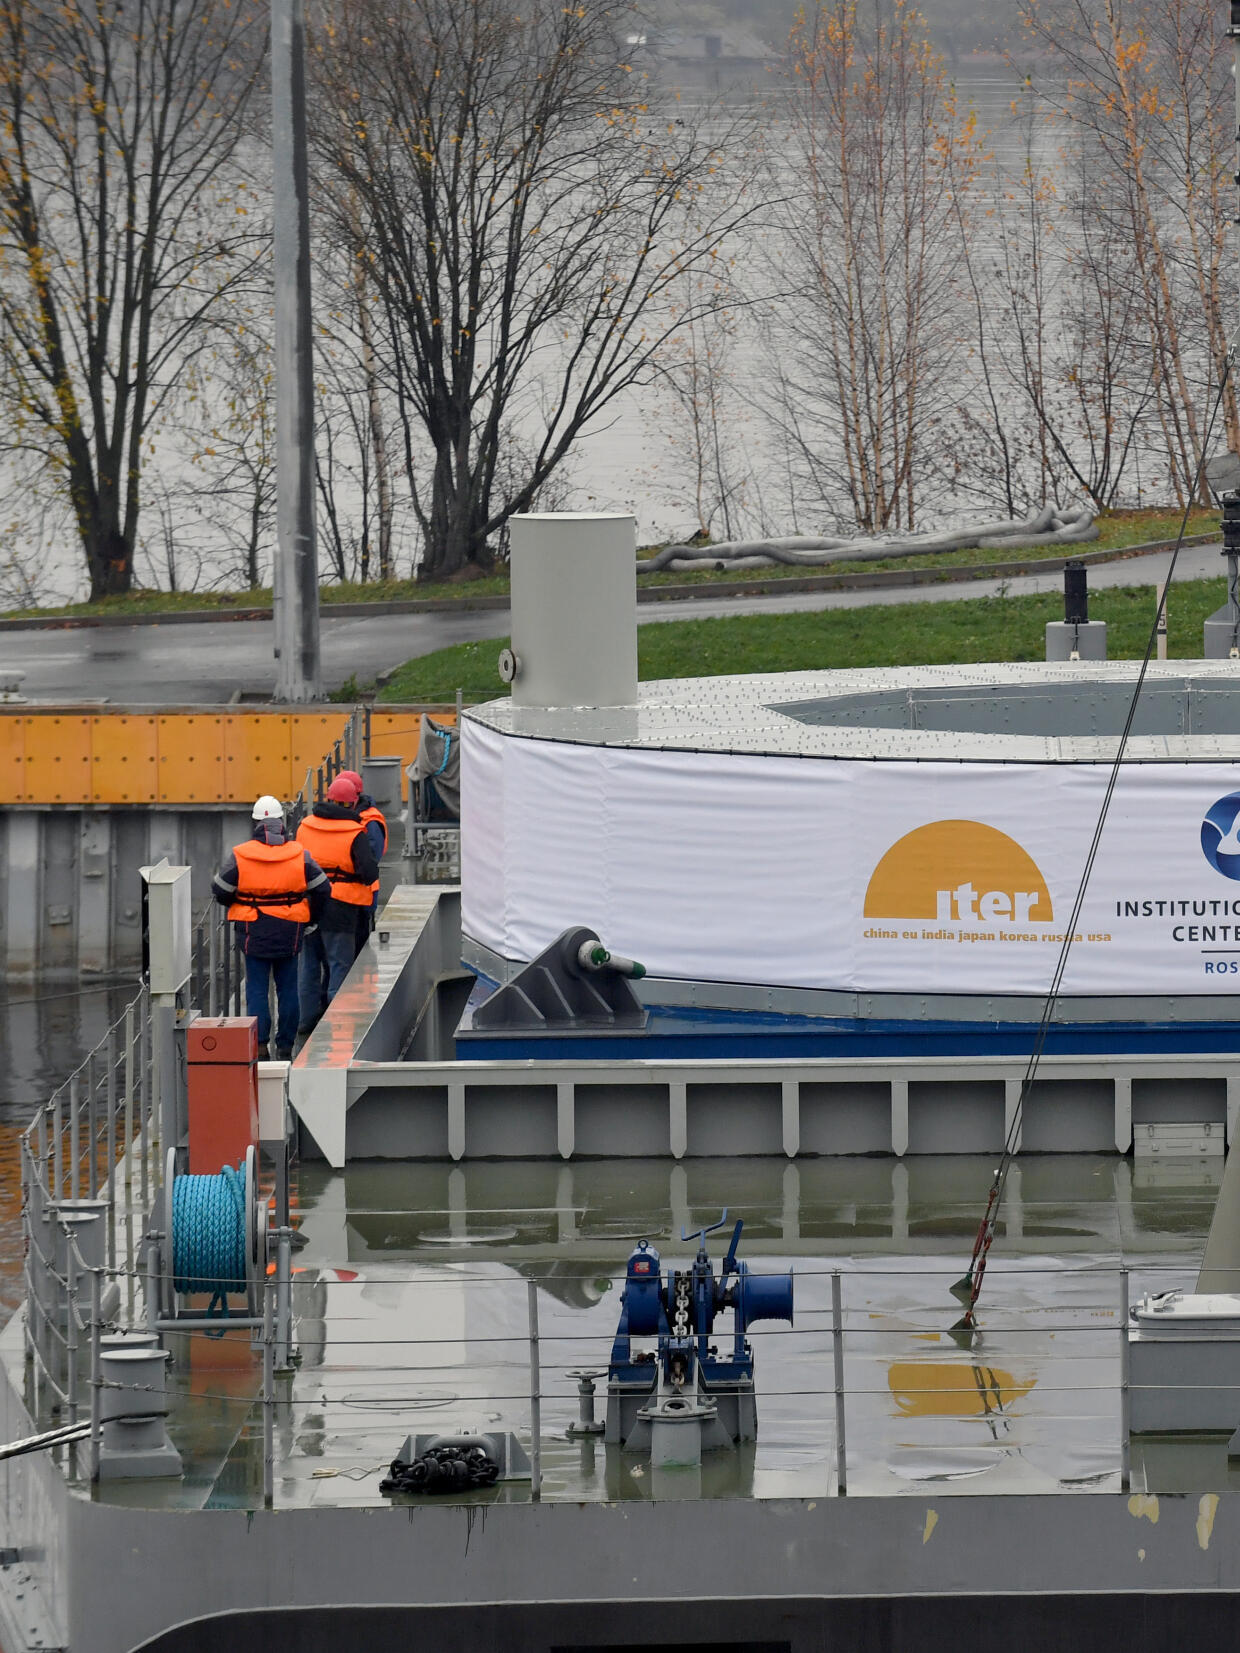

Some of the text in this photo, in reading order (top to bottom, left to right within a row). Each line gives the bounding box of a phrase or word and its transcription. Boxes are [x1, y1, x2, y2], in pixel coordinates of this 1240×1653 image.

[863, 928, 898, 939] china
[902, 930, 918, 940] eu
[922, 928, 954, 940] india
[958, 929, 996, 943] japan
[999, 930, 1038, 942] korea
[1087, 932, 1112, 942] usa
